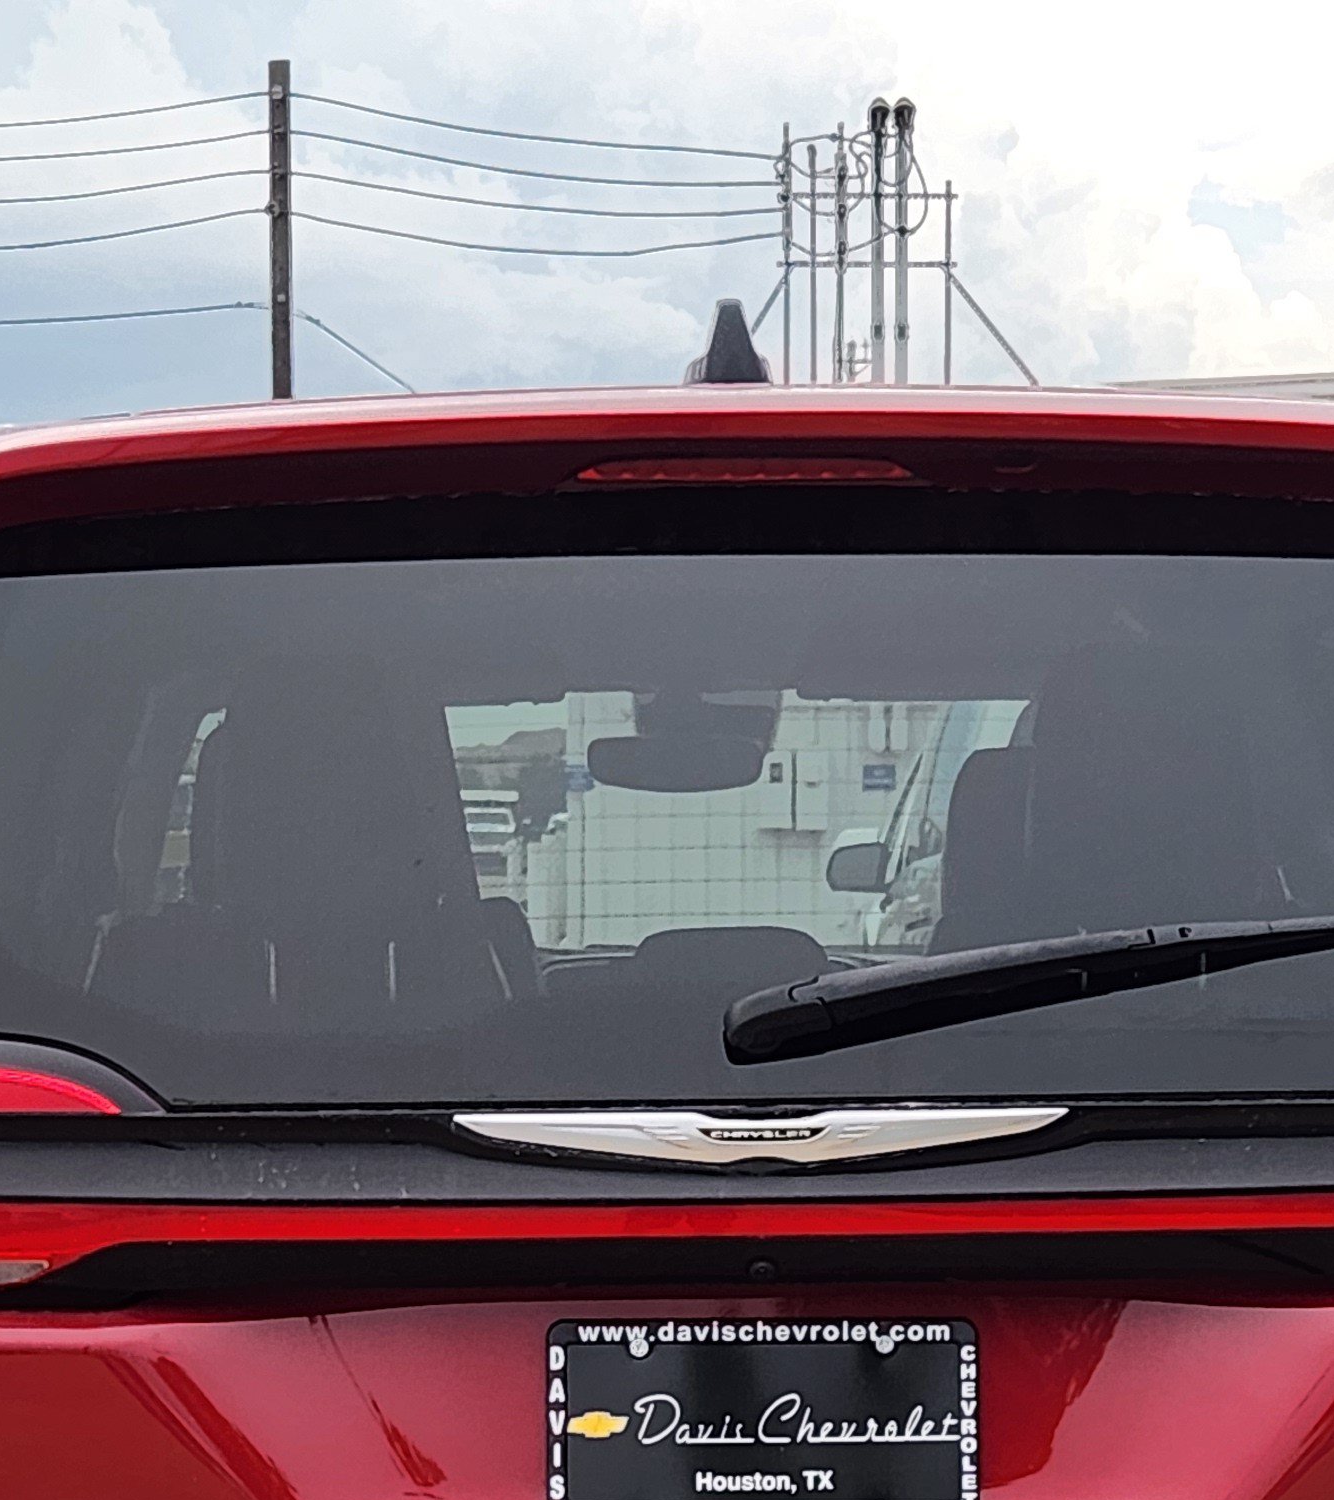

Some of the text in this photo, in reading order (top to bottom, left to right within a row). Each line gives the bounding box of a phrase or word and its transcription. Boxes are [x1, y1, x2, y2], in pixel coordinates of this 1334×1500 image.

[577, 1320, 951, 1343] www.davischevroletcom
[548, 1345, 566, 1500] DAVIS
[633, 1392, 962, 1444] Davis Chevrolet
[695, 1470, 834, 1494] Houston, TX
